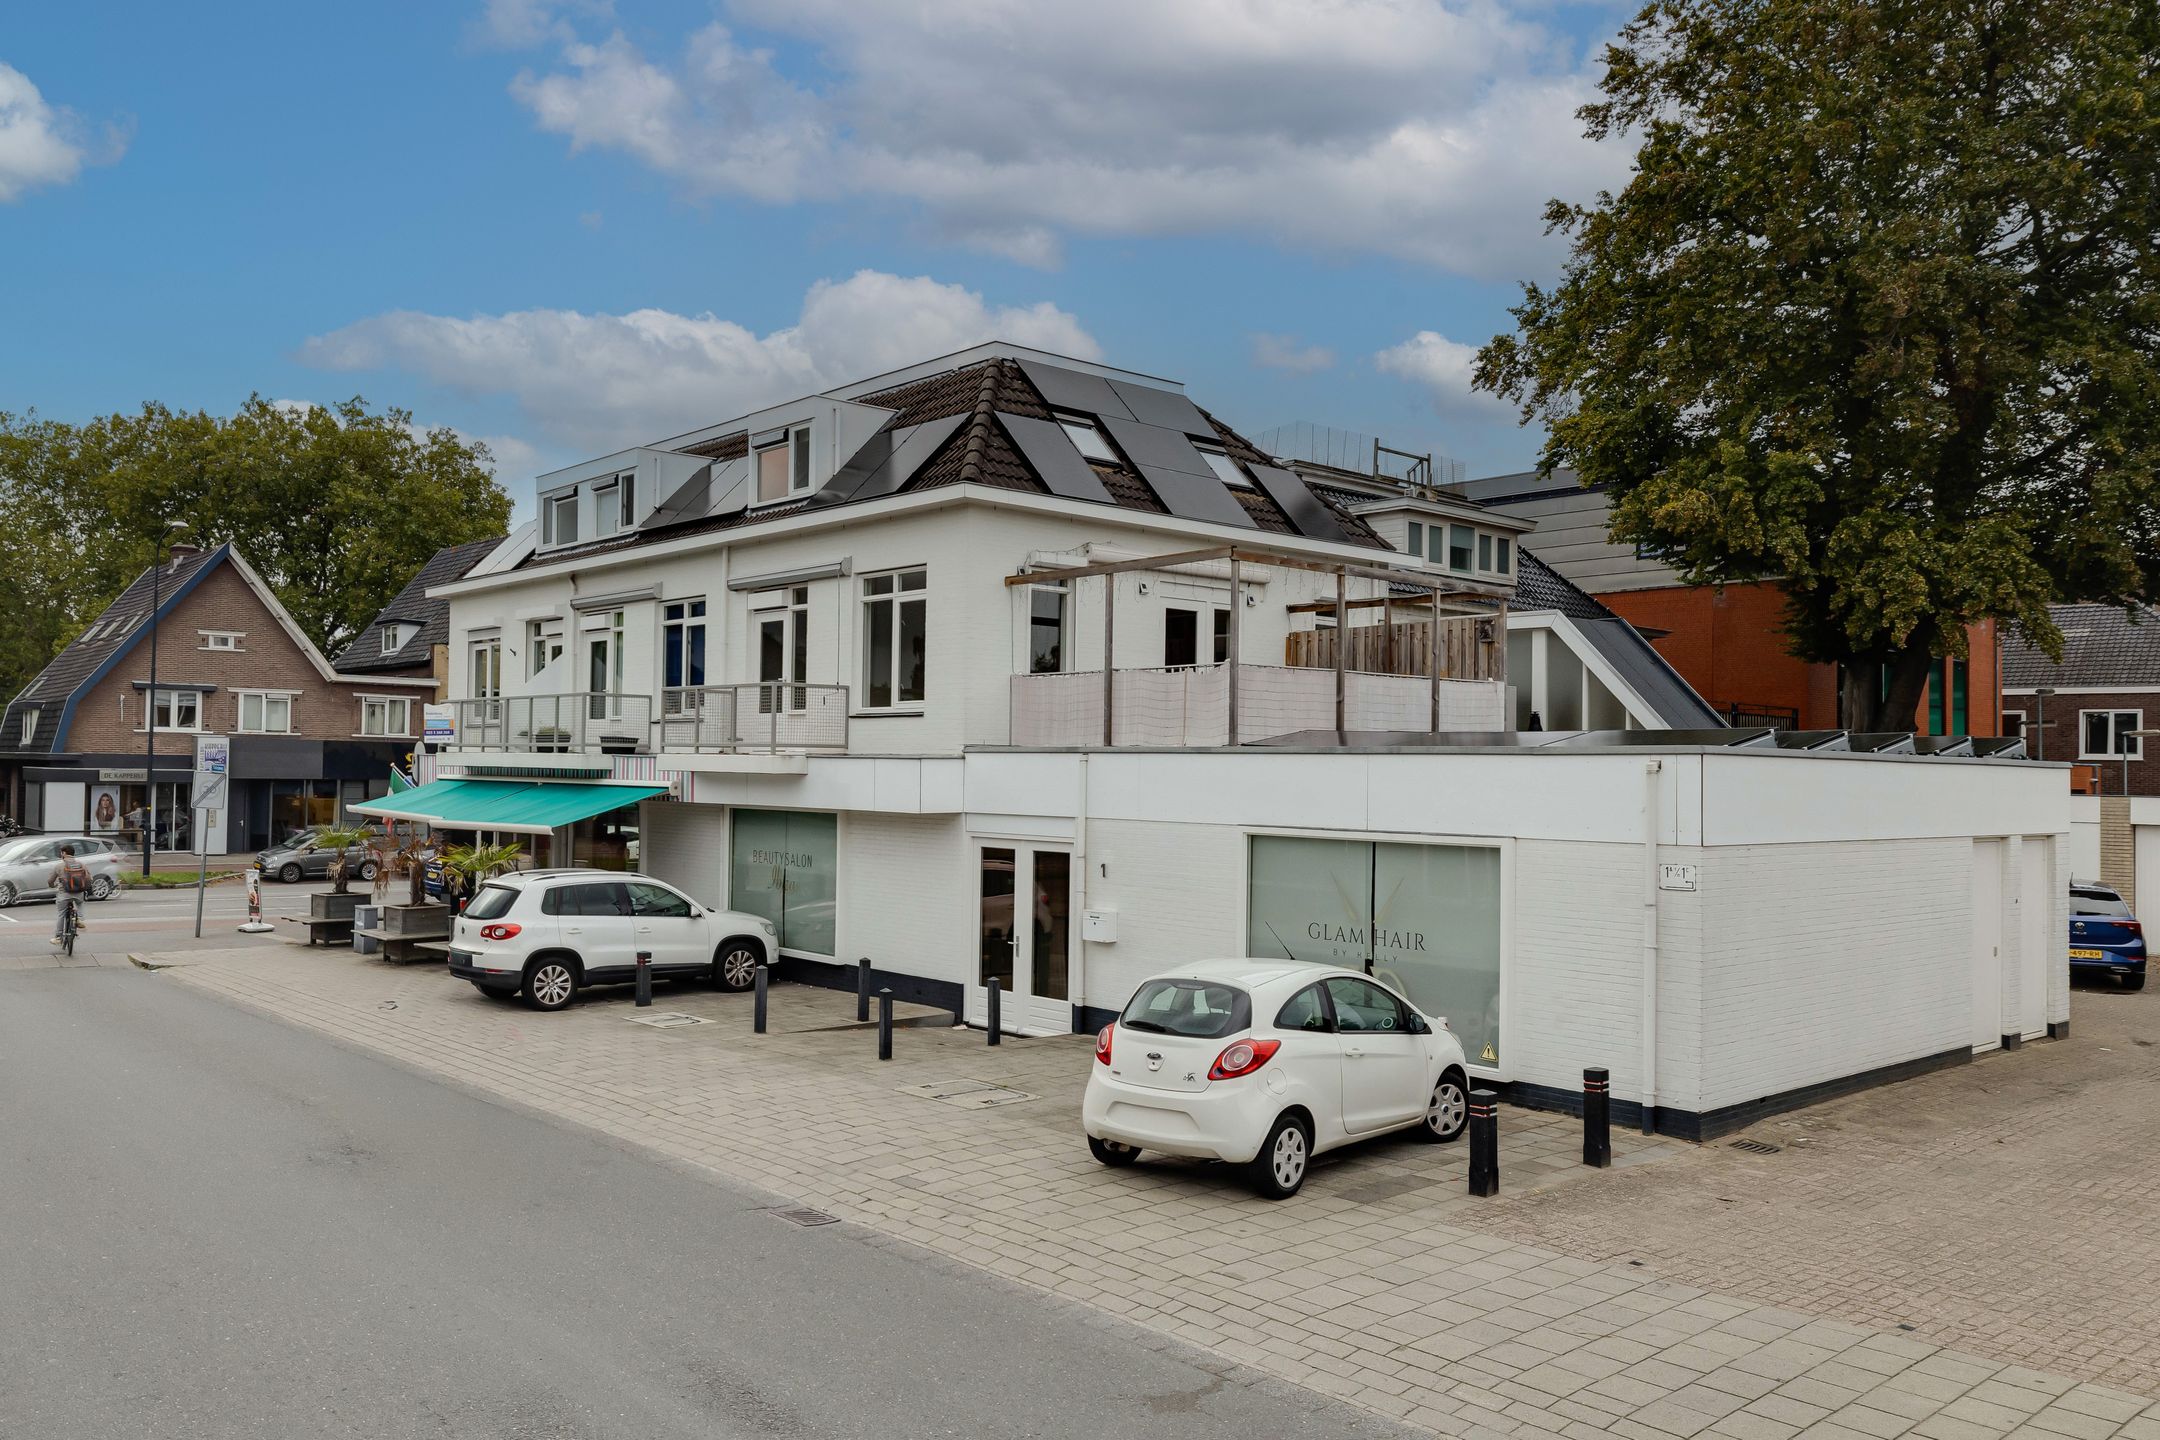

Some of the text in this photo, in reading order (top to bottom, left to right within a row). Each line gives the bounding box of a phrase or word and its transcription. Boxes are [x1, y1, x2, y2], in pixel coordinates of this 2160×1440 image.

[753, 849, 813, 868] BEAUTYSALON
[1101, 863, 1106, 878] 1
[1308, 922, 1426, 951] GLAM HAIR
[1333, 948, 1398, 962] BY KELLY
